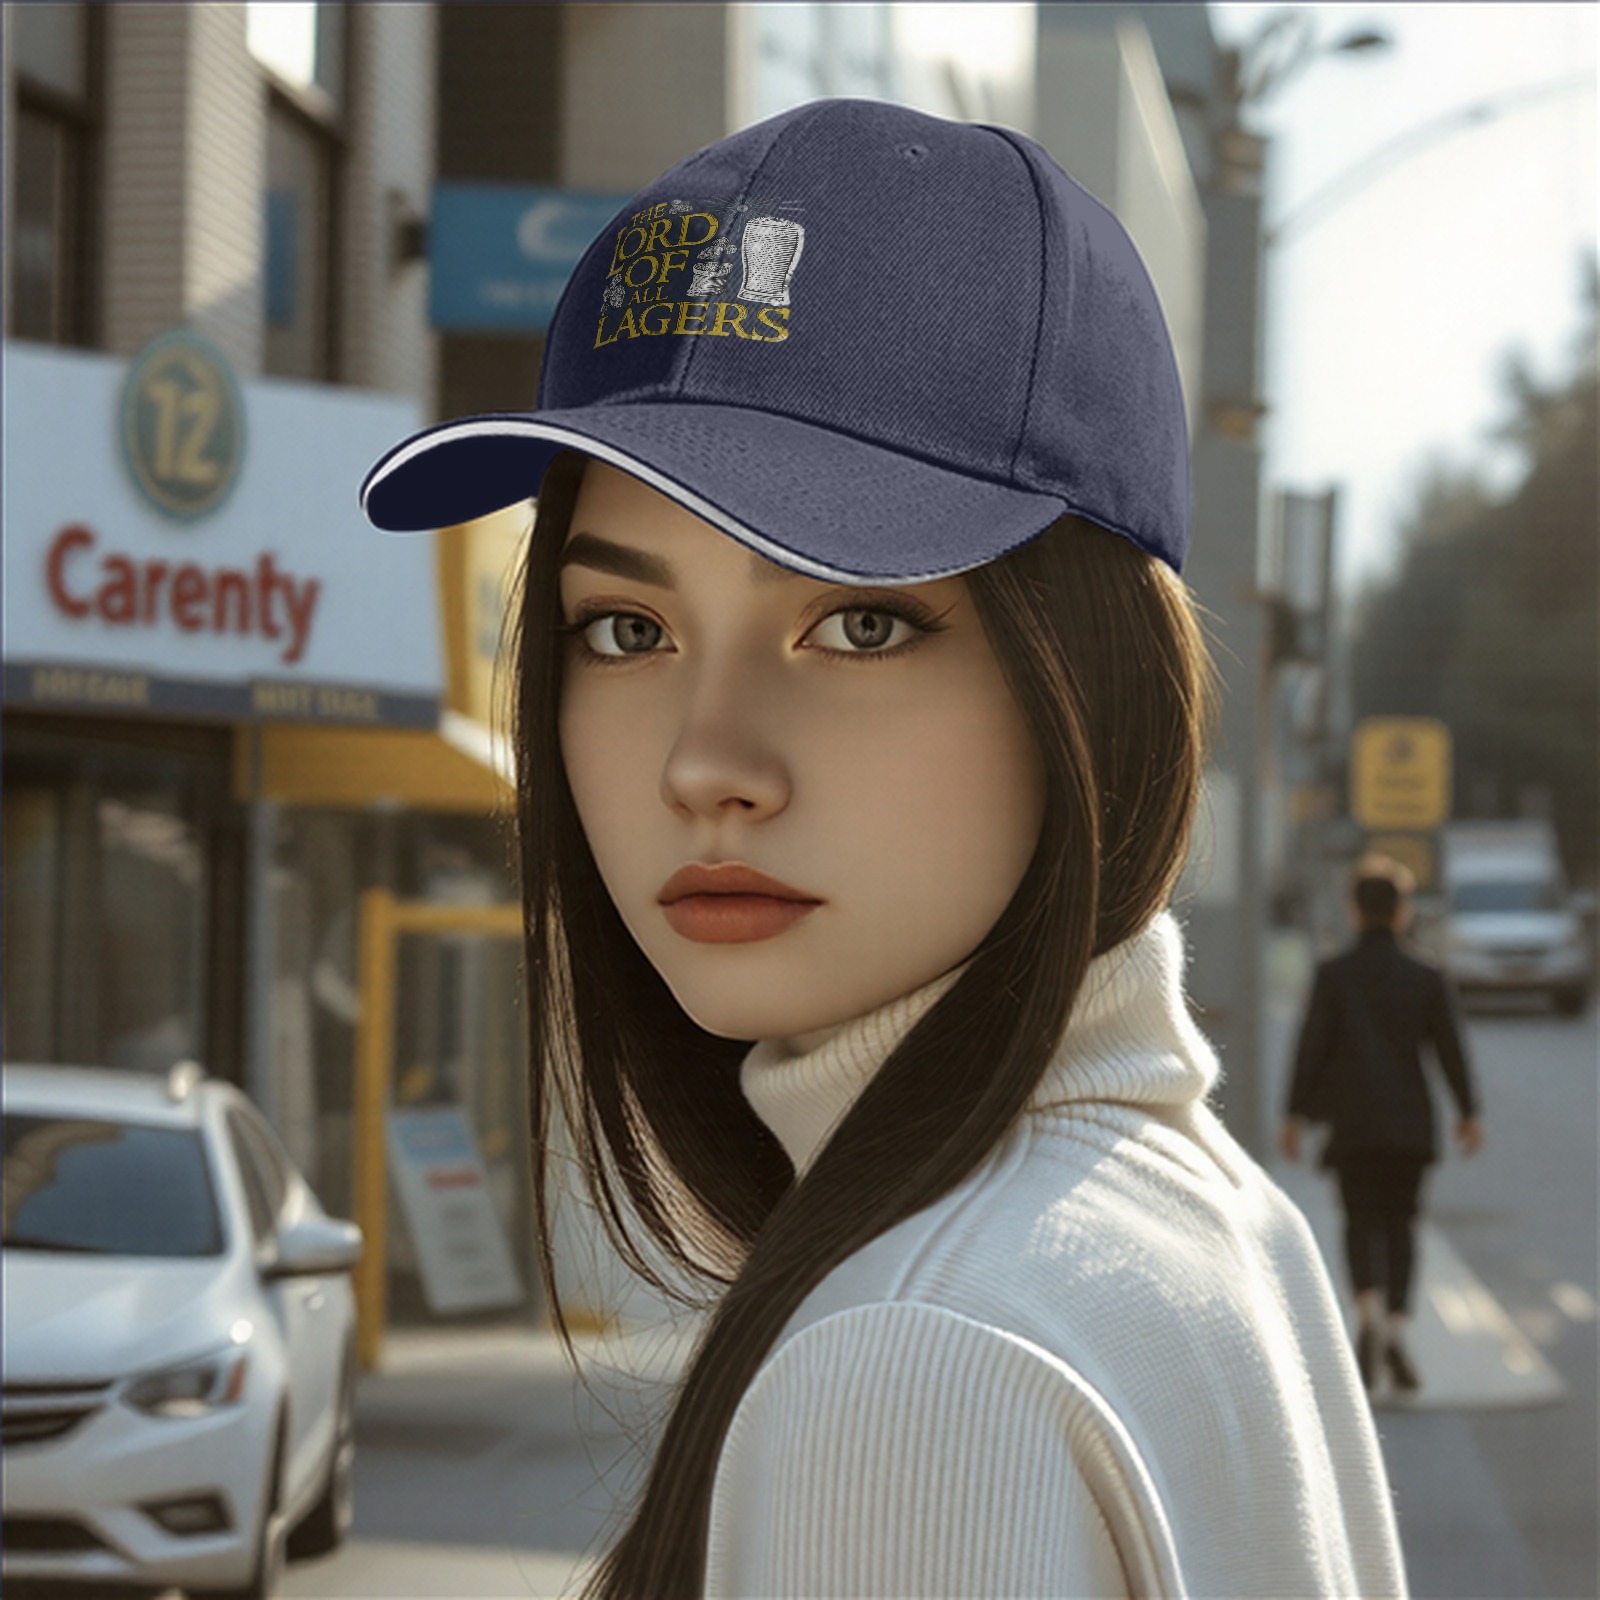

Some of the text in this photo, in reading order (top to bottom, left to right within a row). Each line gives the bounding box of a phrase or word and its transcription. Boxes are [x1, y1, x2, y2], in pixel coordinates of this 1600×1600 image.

[630, 202, 668, 226] THE
[606, 213, 719, 279] LORD
[624, 250, 690, 288] OF
[629, 286, 669, 305] ALL
[593, 302, 790, 350] LAGERS
[45, 525, 320, 665] Carenty
